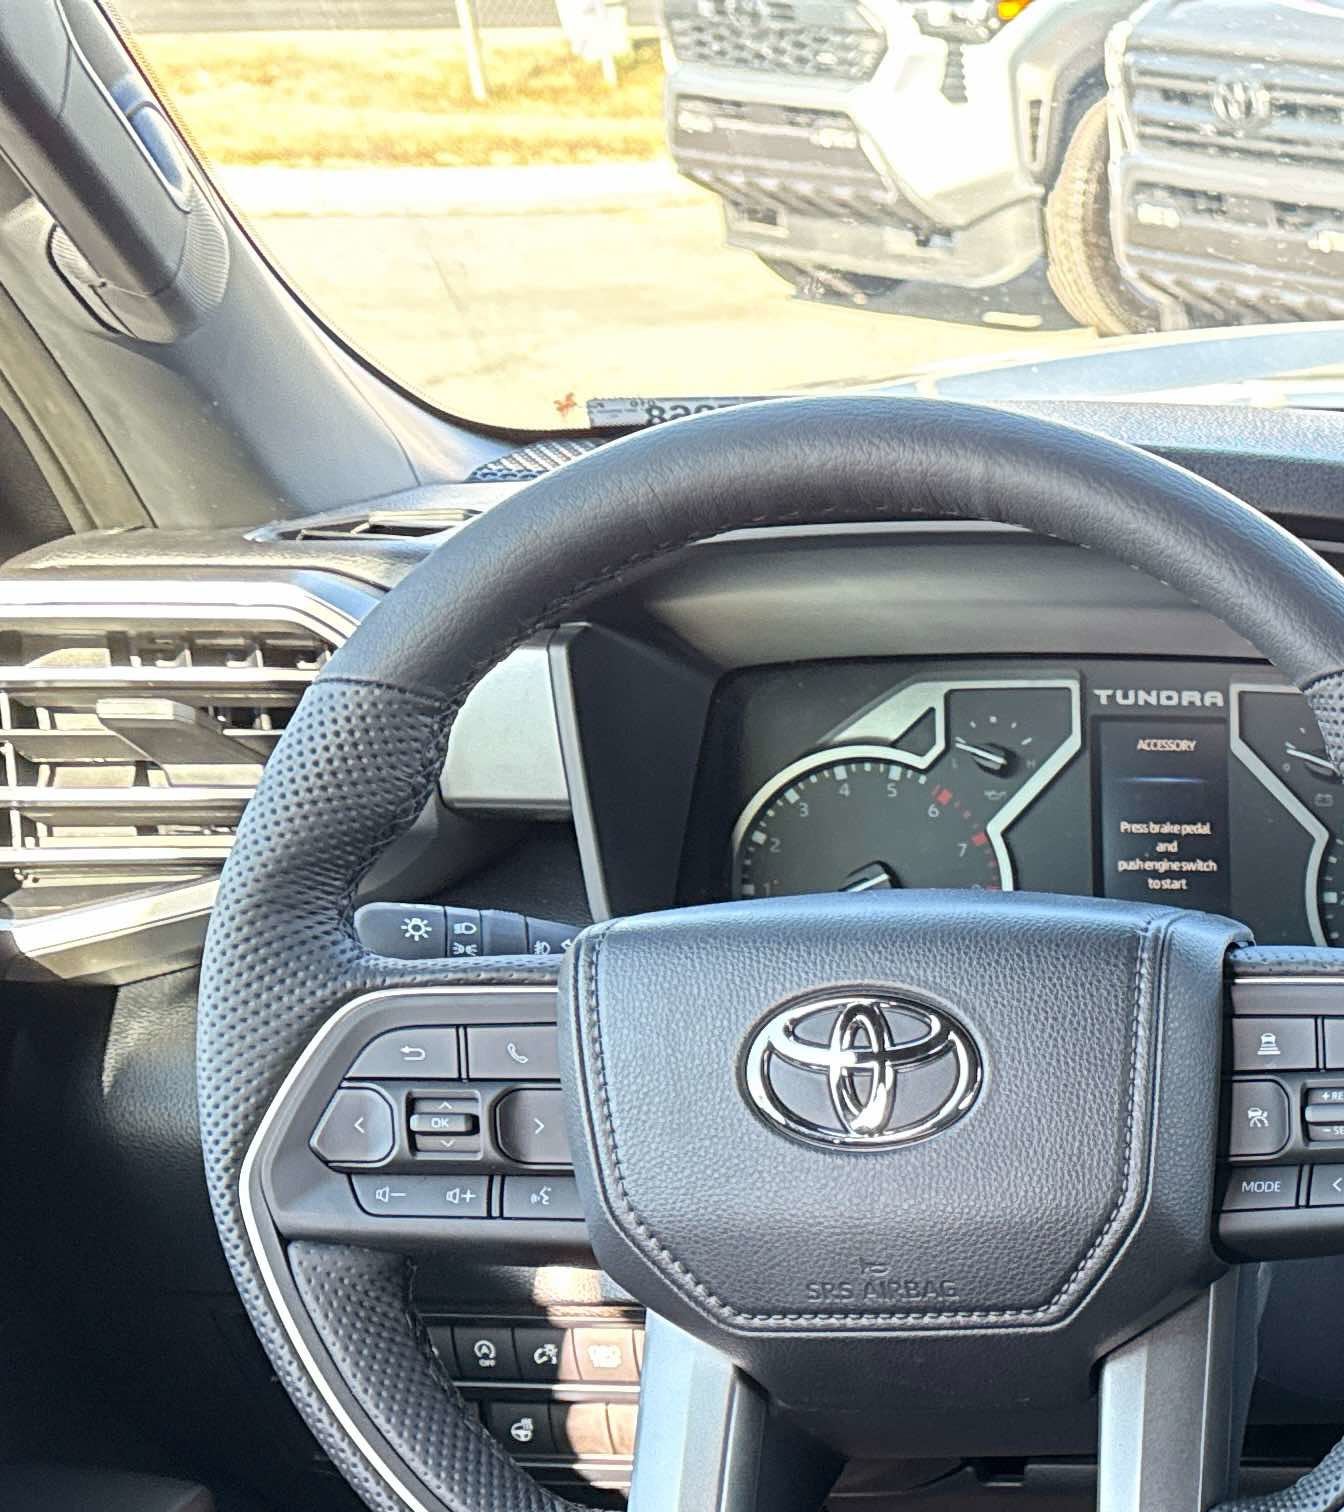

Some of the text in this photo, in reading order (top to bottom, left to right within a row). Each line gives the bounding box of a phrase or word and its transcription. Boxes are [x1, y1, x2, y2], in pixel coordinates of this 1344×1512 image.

[1093, 689, 1225, 707] TUNDRA
[1136, 739, 1198, 752] ACCESSORY
[839, 784, 850, 797] 4
[887, 784, 897, 797] 5
[799, 804, 809, 817] 3
[928, 804, 939, 817] 6
[1120, 821, 1212, 836] Press brake pedal
[770, 838, 781, 852] 2
[957, 843, 968, 857] 7
[1156, 840, 1178, 853] and
[1117, 858, 1217, 873] push engine switch
[1148, 878, 1187, 890] to start
[431, 1117, 449, 1128] OK
[1241, 1181, 1281, 1193] MODE
[807, 1280, 960, 1302] SRS AIRBAG
